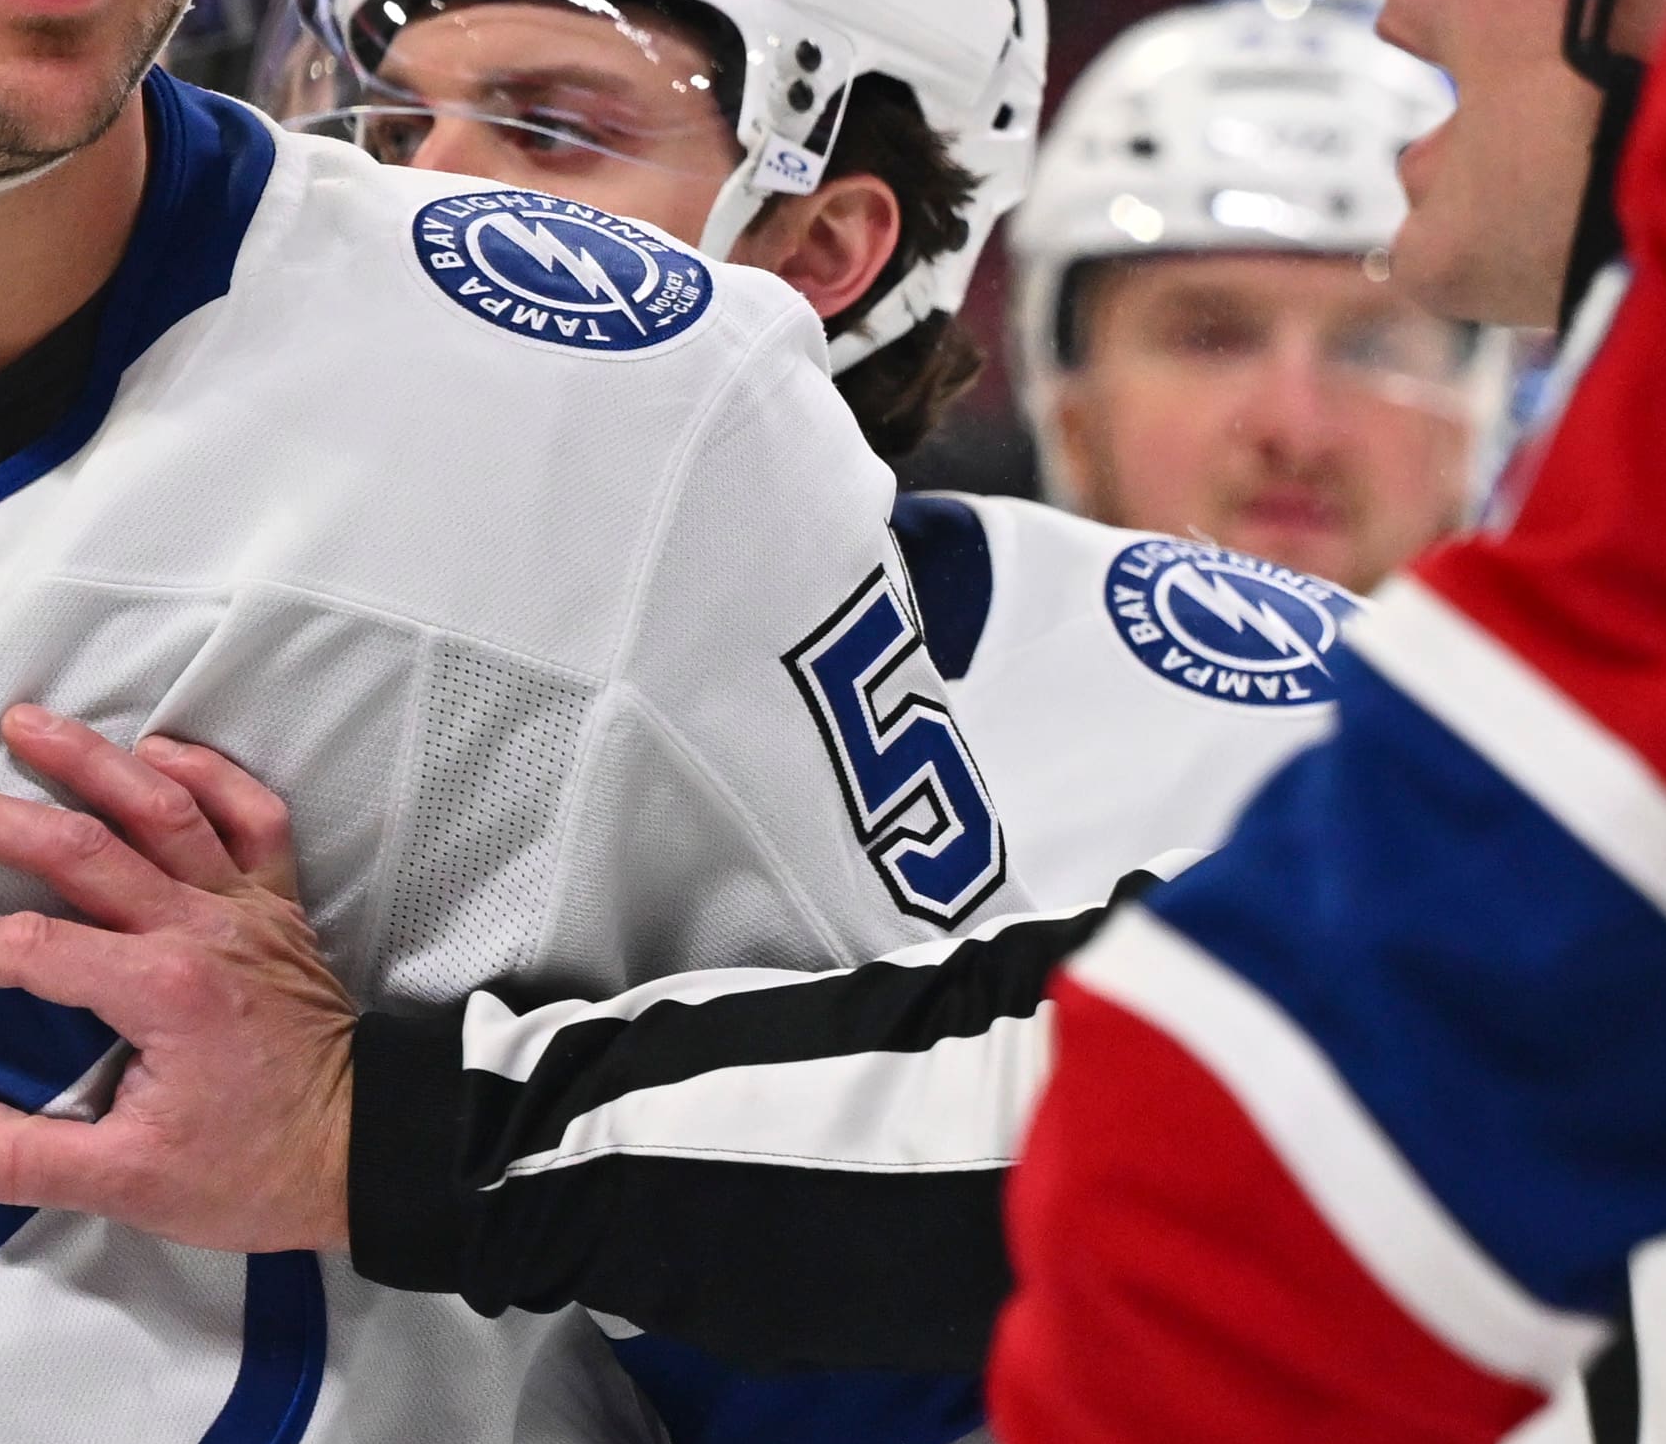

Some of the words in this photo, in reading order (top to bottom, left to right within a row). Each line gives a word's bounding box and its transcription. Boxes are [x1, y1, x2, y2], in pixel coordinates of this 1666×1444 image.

[422, 219, 467, 271] BAY
[444, 195, 671, 255] LIGHTNING
[458, 275, 612, 342] TAMPA
[645, 269, 684, 316] HOCKEY
[672, 285, 702, 316] CLUB
[1113, 584, 1164, 645] BAY
[1161, 646, 1312, 700] TAMPA
[780, 522, 1006, 932] 5
